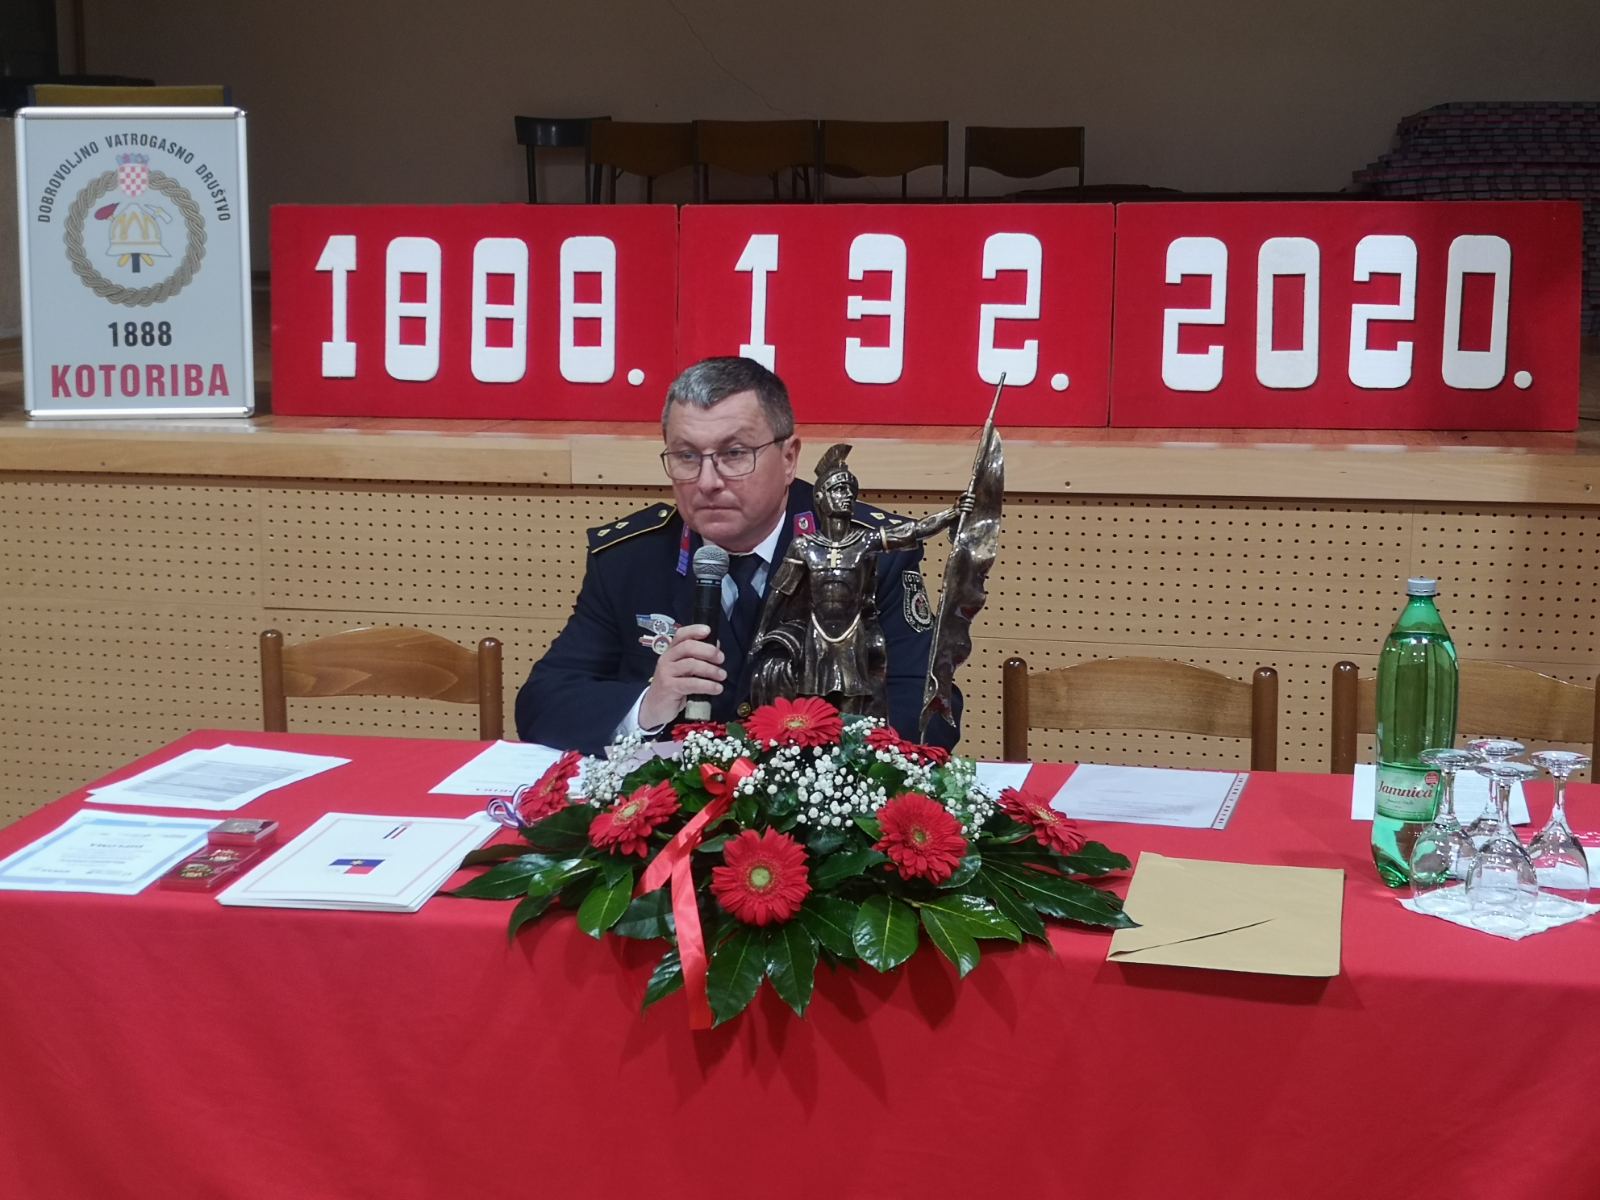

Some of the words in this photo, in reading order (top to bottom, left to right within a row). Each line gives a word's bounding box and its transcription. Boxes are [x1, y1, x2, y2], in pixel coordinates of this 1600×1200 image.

[38, 141, 99, 223] DOBROVOLJNO
[105, 133, 195, 164] VATROGASNO
[195, 164, 231, 221] DRUŠTVO
[315, 235, 645, 385] 1888.
[1161, 235, 1533, 391] 2020.
[107, 321, 173, 347] 1888
[51, 364, 230, 398] KOTORIBA
[1378, 781, 1433, 798] Jamnica
